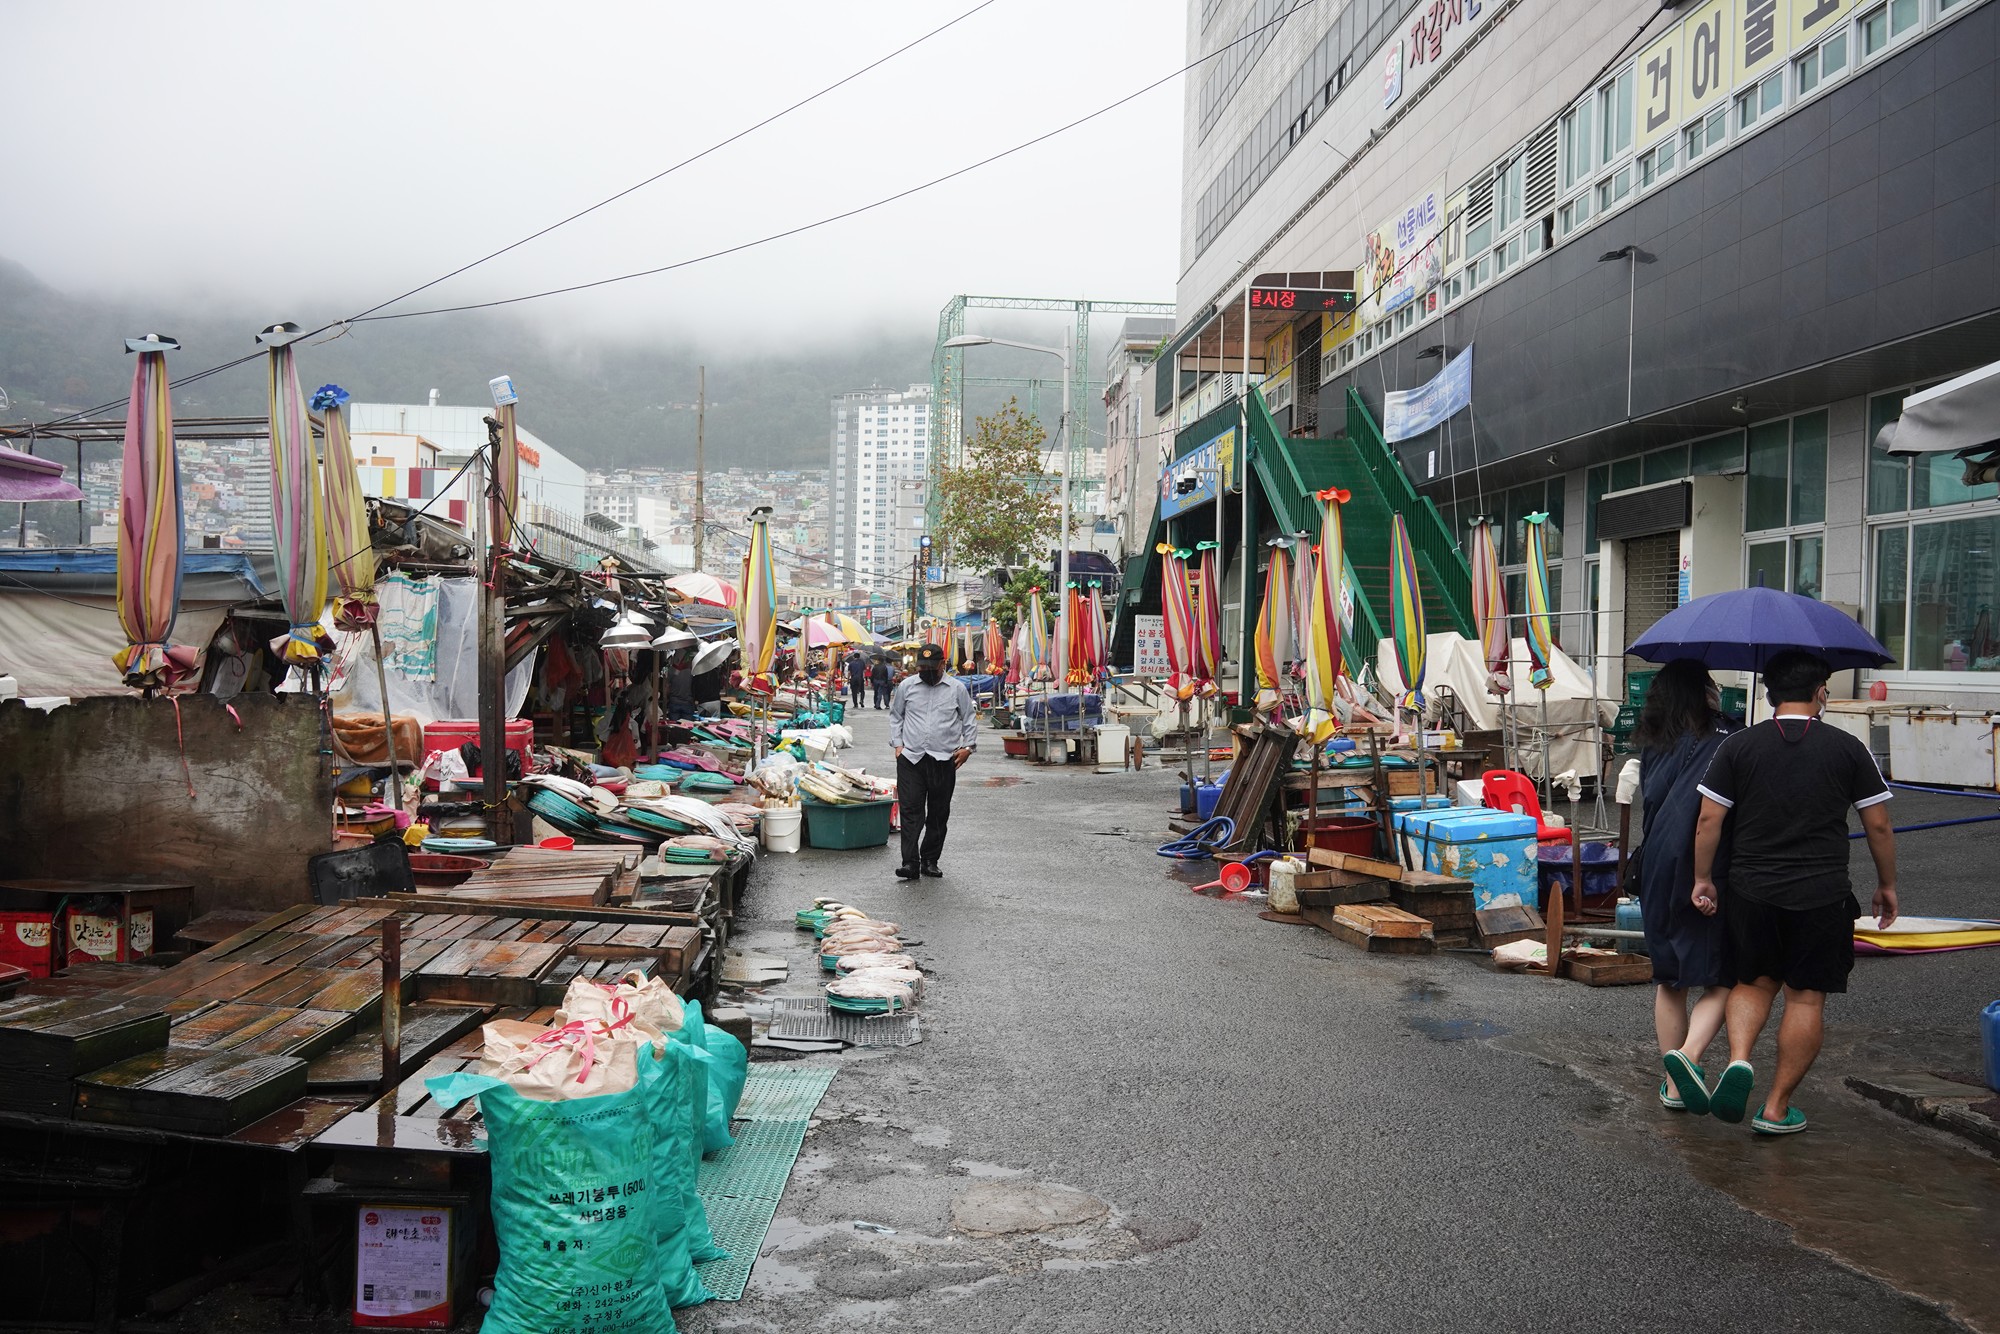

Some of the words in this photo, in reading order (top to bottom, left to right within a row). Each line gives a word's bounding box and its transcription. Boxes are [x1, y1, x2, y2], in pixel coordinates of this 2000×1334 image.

[1397, 192, 1436, 249] 선물세트
[75, 920, 104, 940] 맛있는
[579, 1204, 627, 1223] 사업장용
[385, 1226, 421, 1241] 태양초
